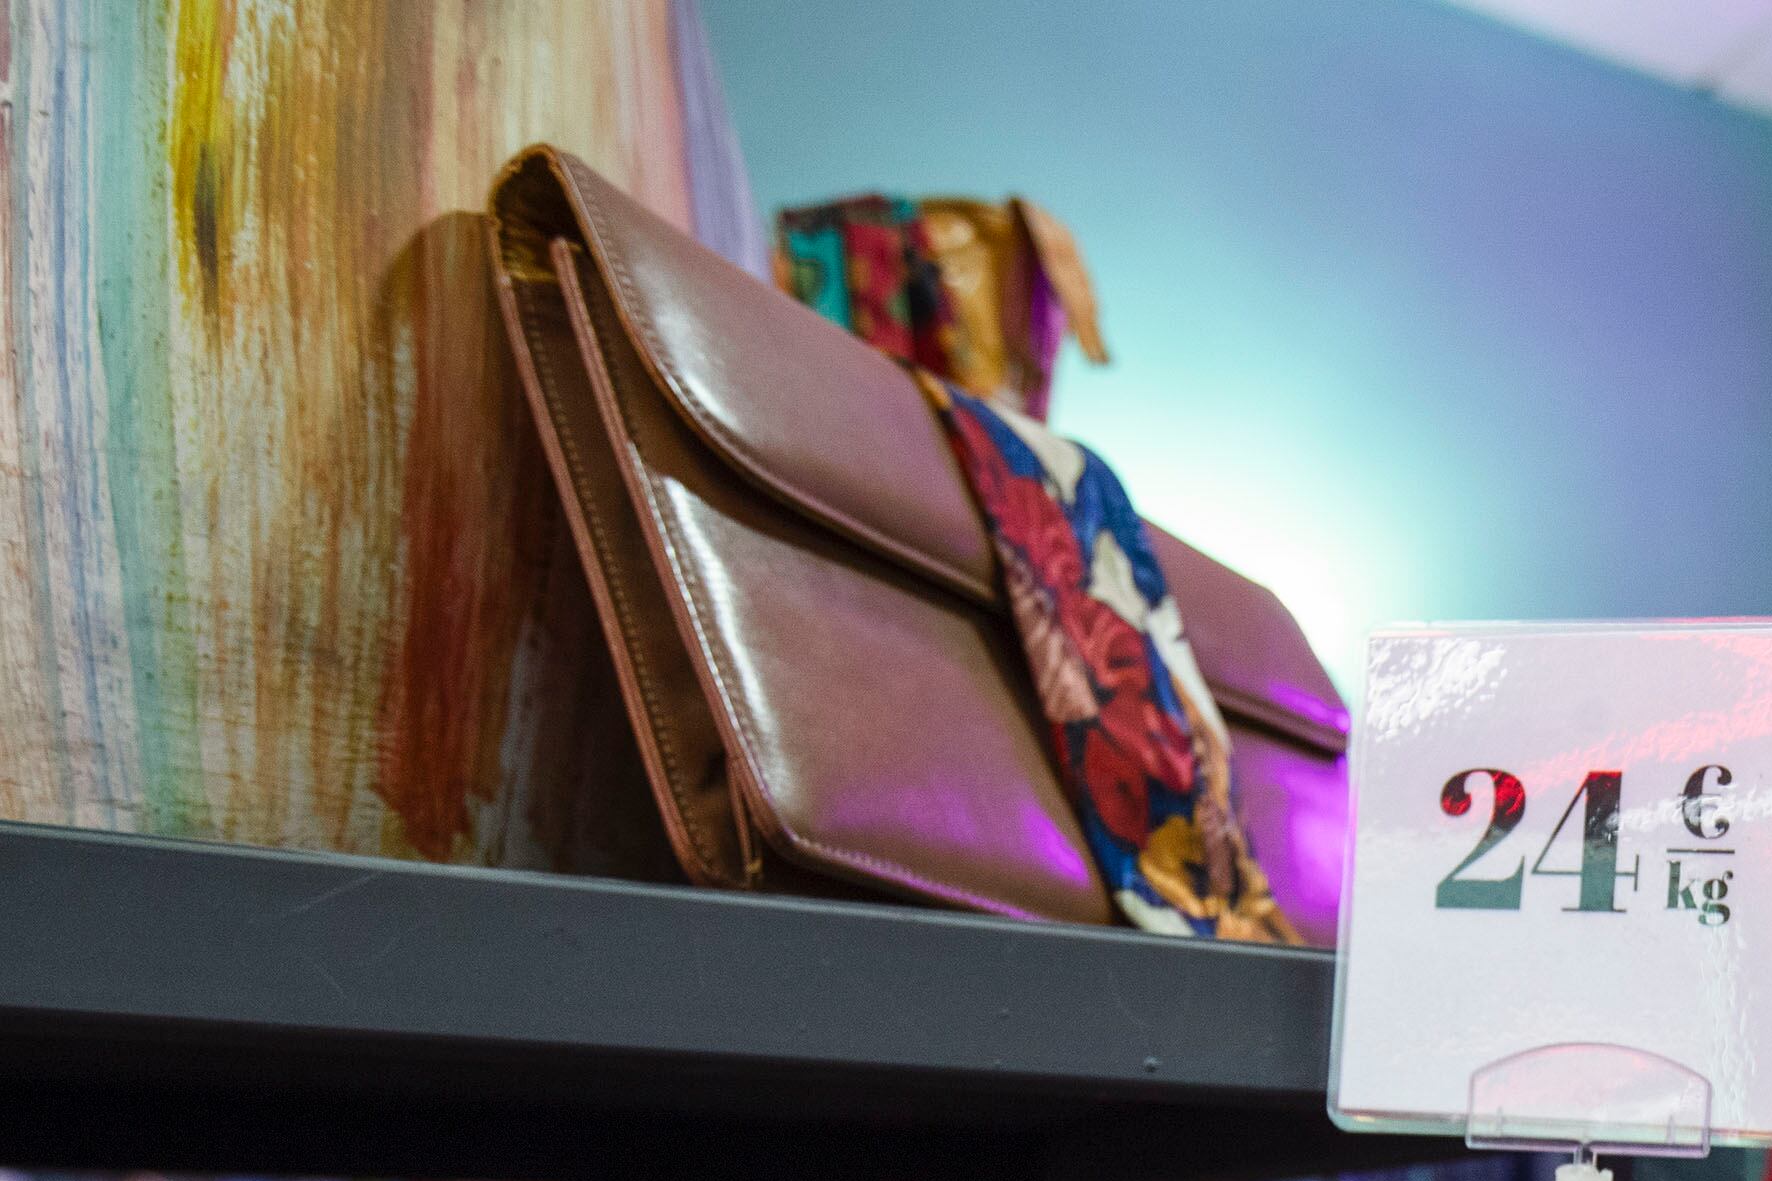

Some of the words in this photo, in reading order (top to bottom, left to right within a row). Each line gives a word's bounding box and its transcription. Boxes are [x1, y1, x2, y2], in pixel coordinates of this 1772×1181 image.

[1435, 767, 1639, 914] 24
[1678, 764, 1733, 840] €
[1665, 859, 1735, 927] kg
